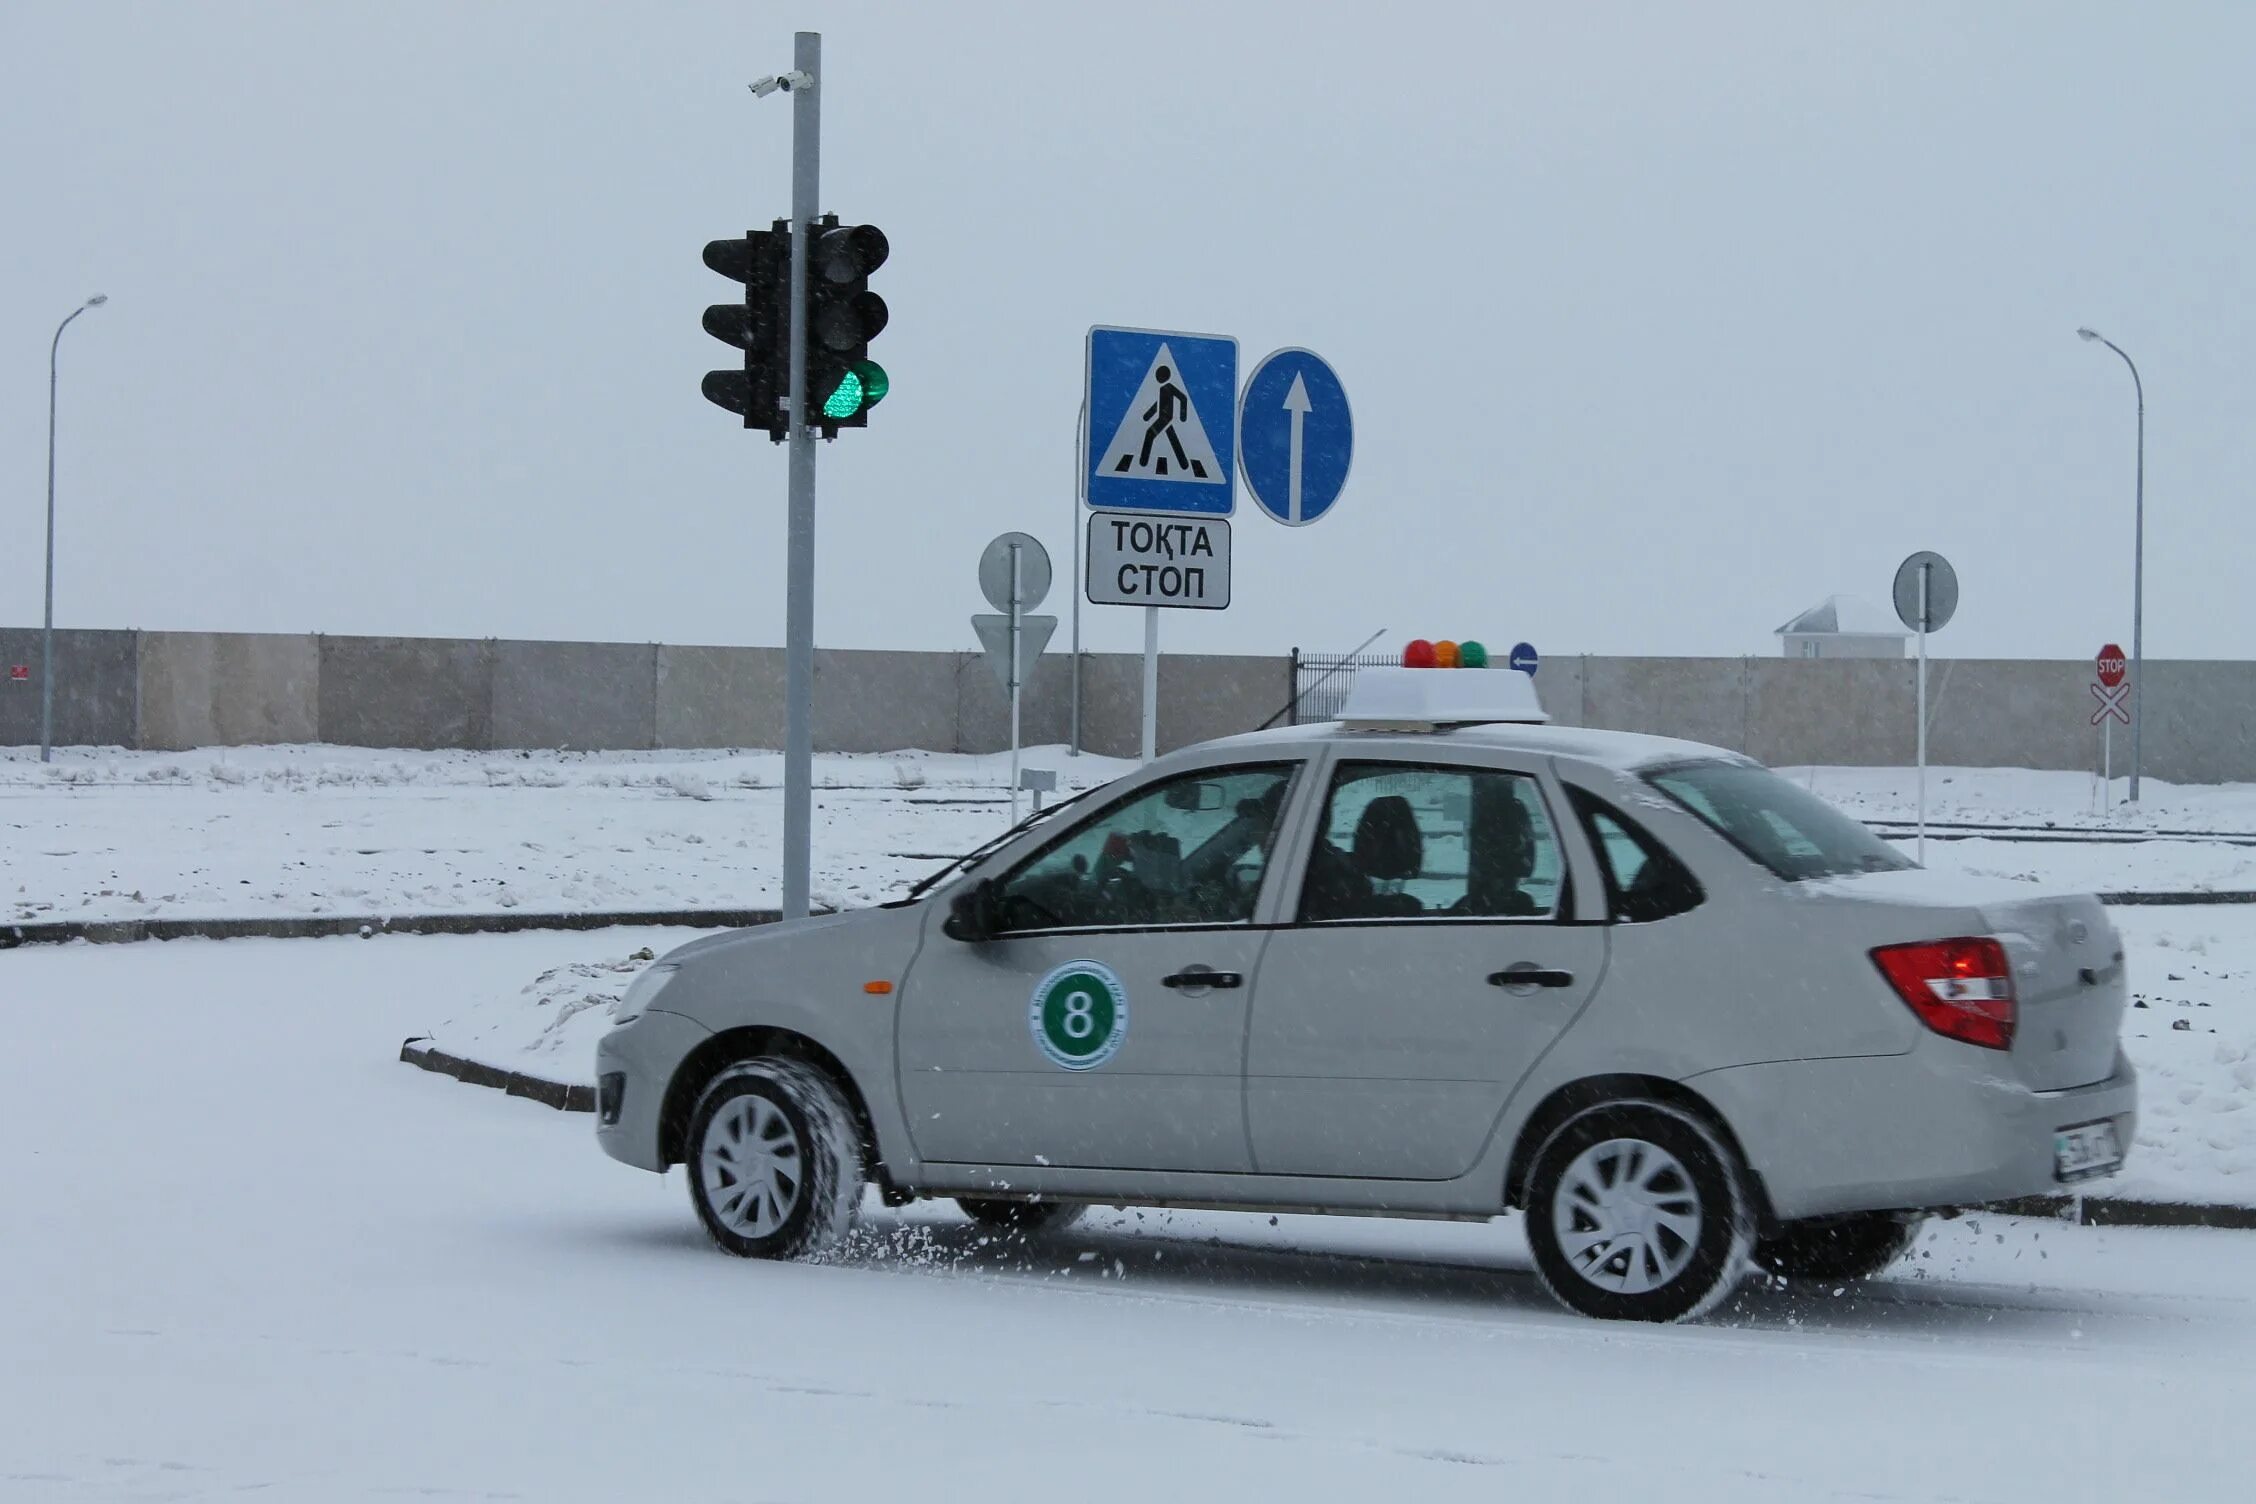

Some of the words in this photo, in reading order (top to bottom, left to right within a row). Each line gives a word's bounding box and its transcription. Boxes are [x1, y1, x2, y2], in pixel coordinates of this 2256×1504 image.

[1111, 520, 1213, 561] ТОҚТА
[1117, 563, 1204, 598] СТОП
[2099, 659, 2124, 673] STOP
[1063, 991, 1094, 1038] 8
